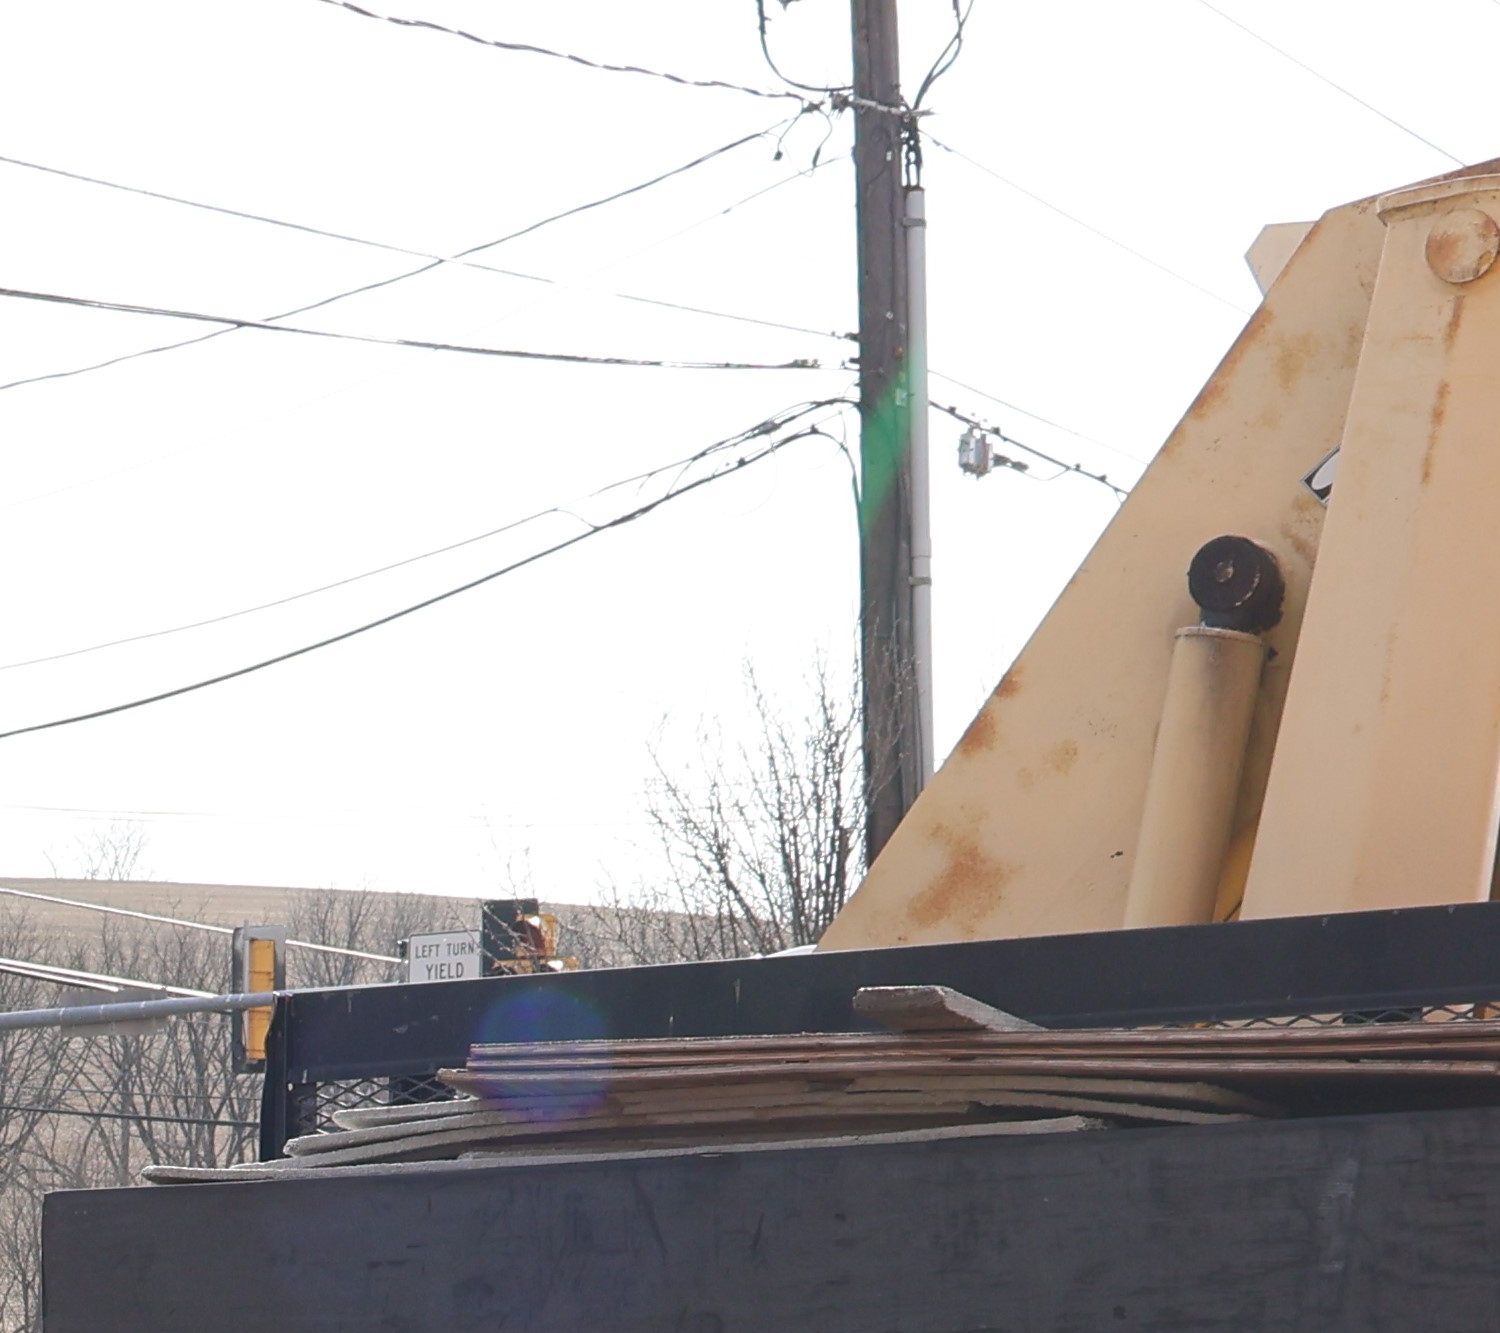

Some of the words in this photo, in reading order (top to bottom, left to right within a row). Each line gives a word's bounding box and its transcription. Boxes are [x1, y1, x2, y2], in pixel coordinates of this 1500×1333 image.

[415, 943, 440, 959] LEFT
[446, 942, 474, 956] TURN
[425, 962, 465, 981] YIELD
